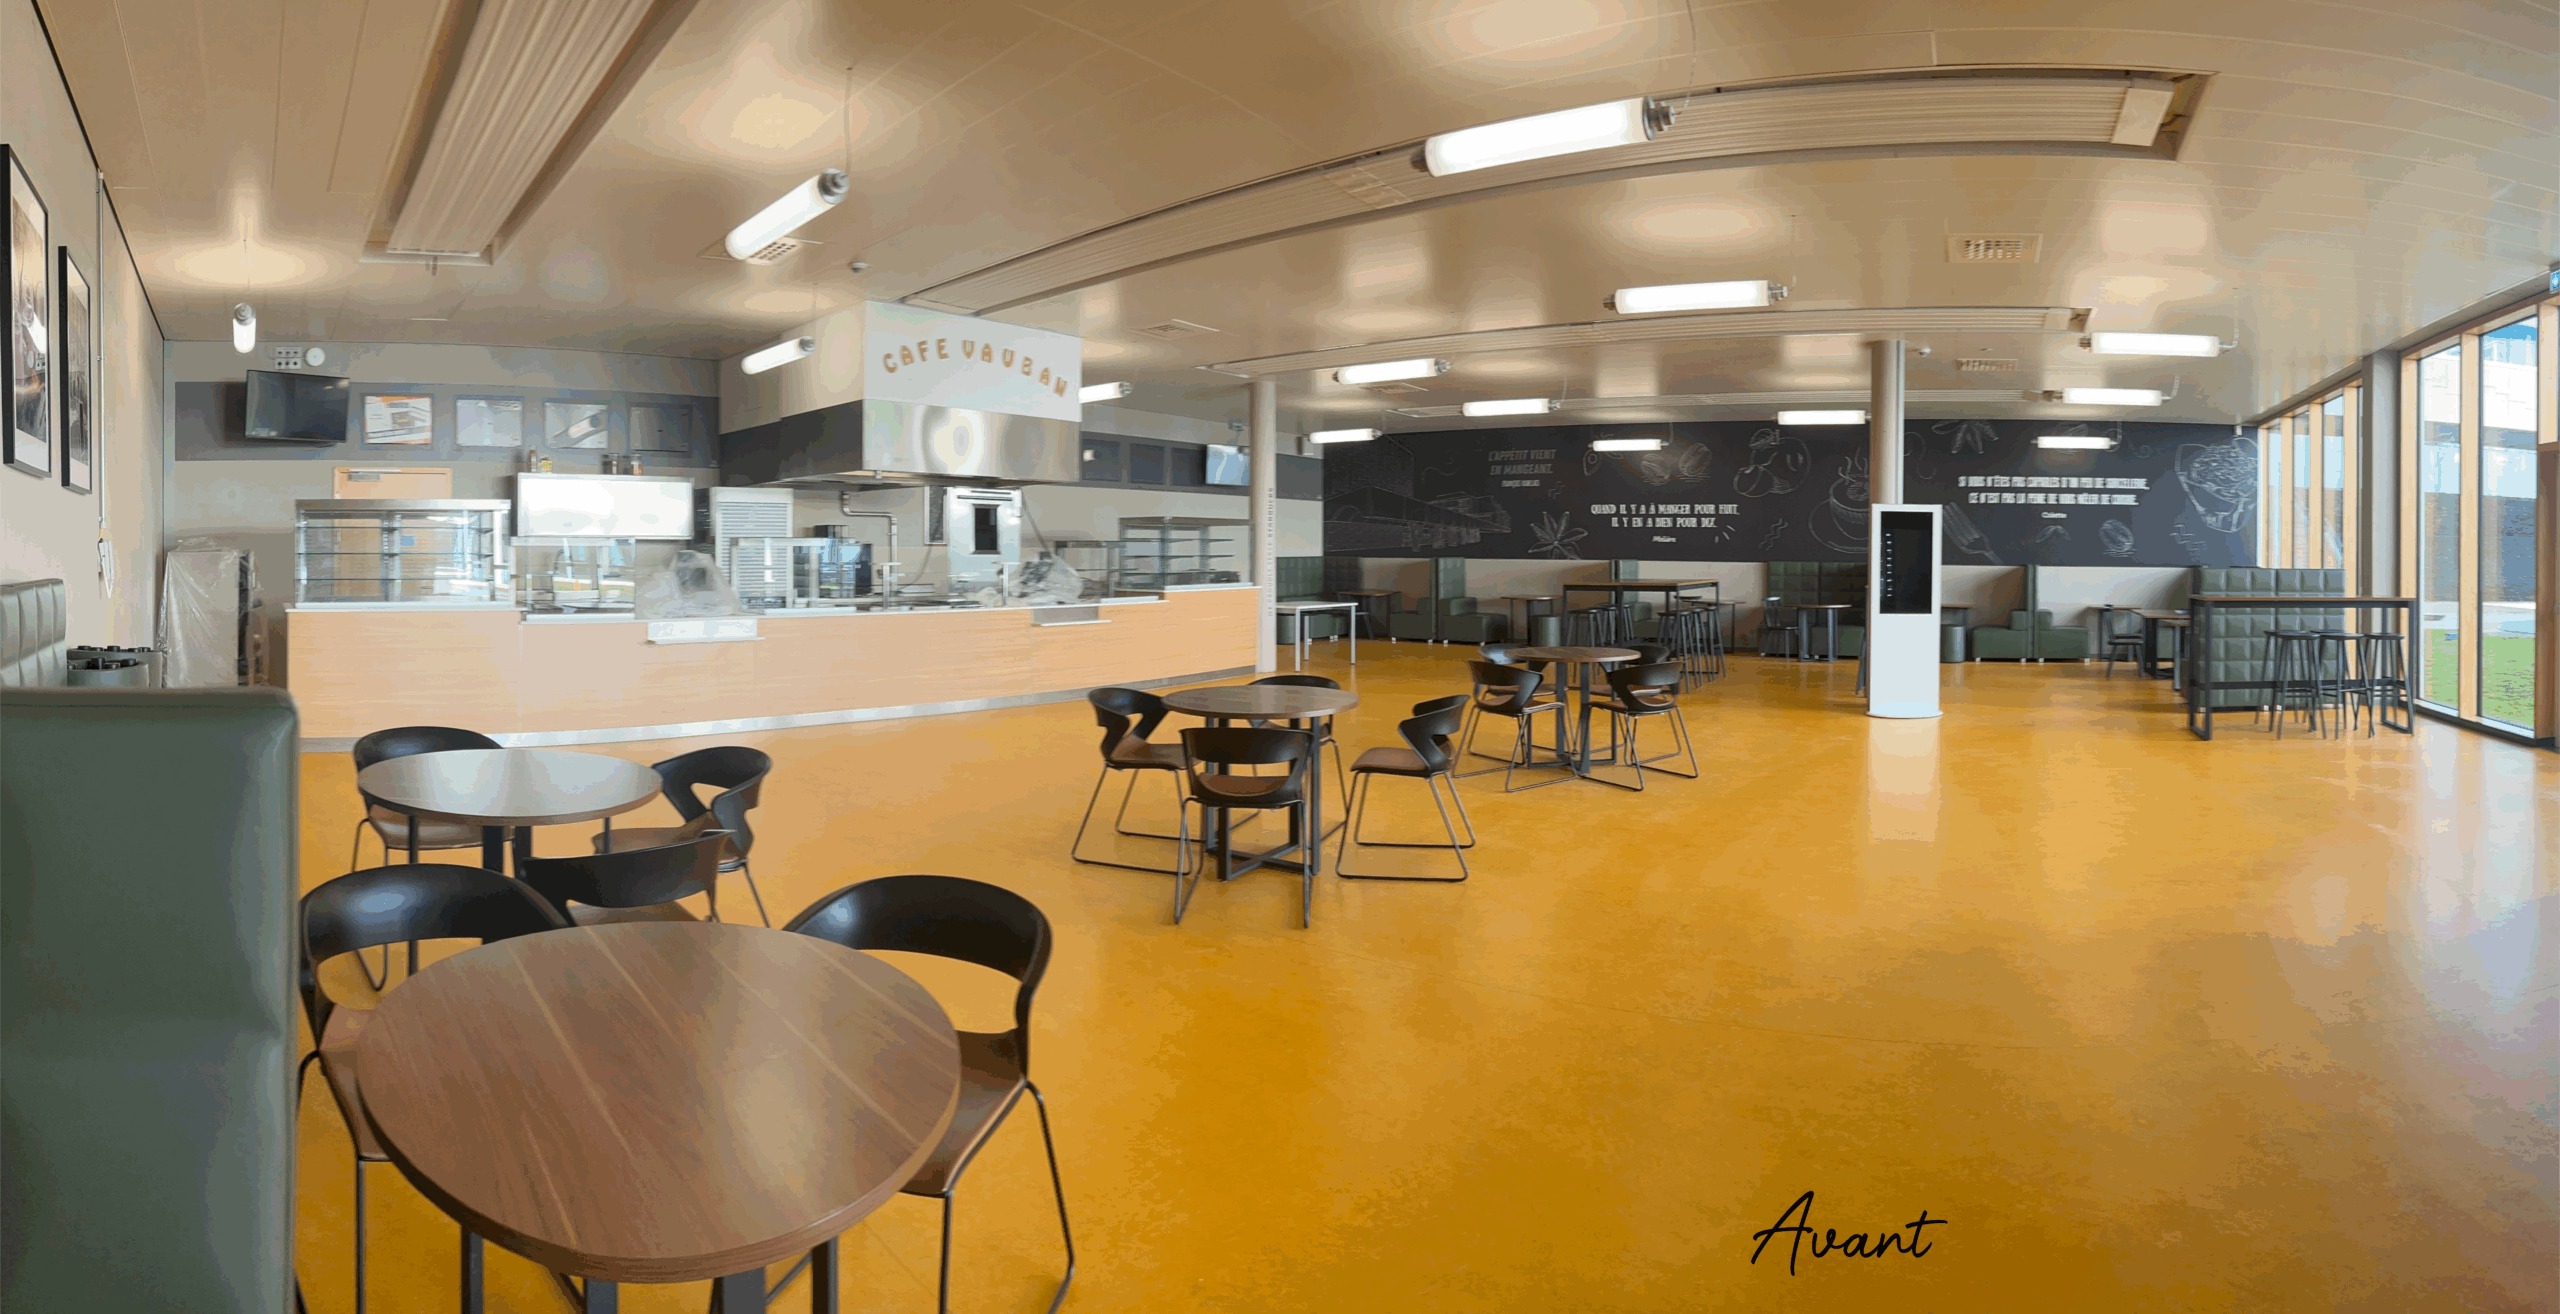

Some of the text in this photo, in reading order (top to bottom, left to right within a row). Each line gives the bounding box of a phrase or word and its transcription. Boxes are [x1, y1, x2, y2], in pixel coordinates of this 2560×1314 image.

[882, 338, 1068, 398] CAFE VAUBAN
[1590, 504, 1617, 515] QUAND
[1619, 504, 1628, 514] IL
[1629, 504, 1637, 514] Y
[1638, 504, 1647, 514] A
[1657, 504, 1691, 514] MANGER
[1693, 504, 1716, 514] POUR
[1622, 517, 1629, 527] Y
[1631, 517, 1643, 527] EN
[1645, 517, 1653, 527] A
[1676, 517, 1698, 527] POUR
